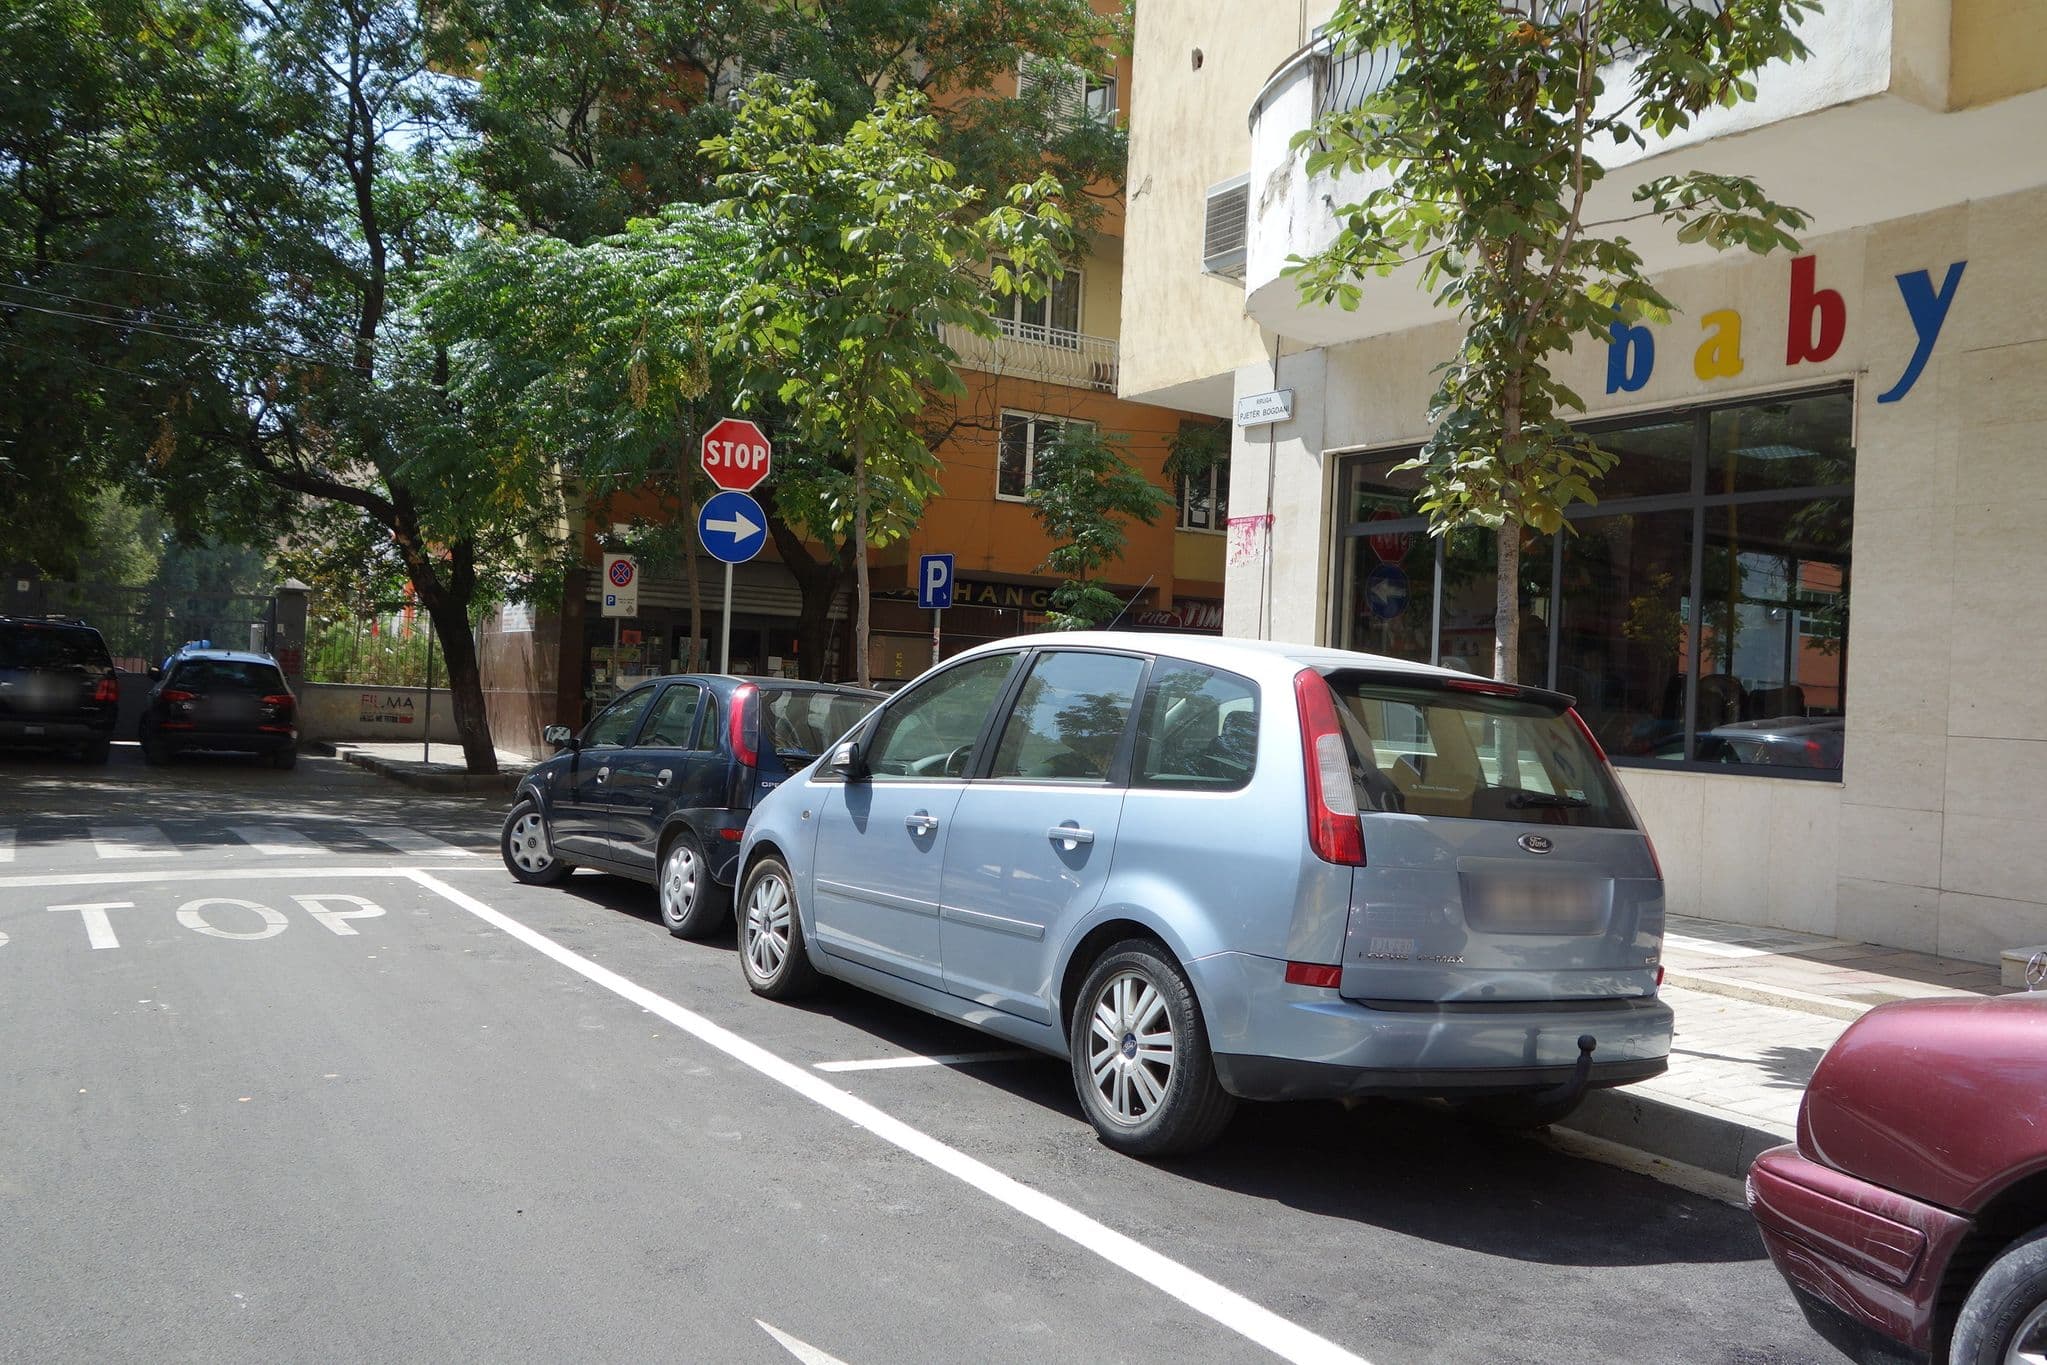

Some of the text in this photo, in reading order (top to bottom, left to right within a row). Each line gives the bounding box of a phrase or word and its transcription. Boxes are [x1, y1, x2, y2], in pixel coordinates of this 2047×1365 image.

[1605, 254, 1969, 404] baby
[1263, 405, 1290, 416] BOGDANI
[706, 439, 766, 470] STOP
[926, 560, 948, 603] P
[0, 893, 387, 951] TOP
